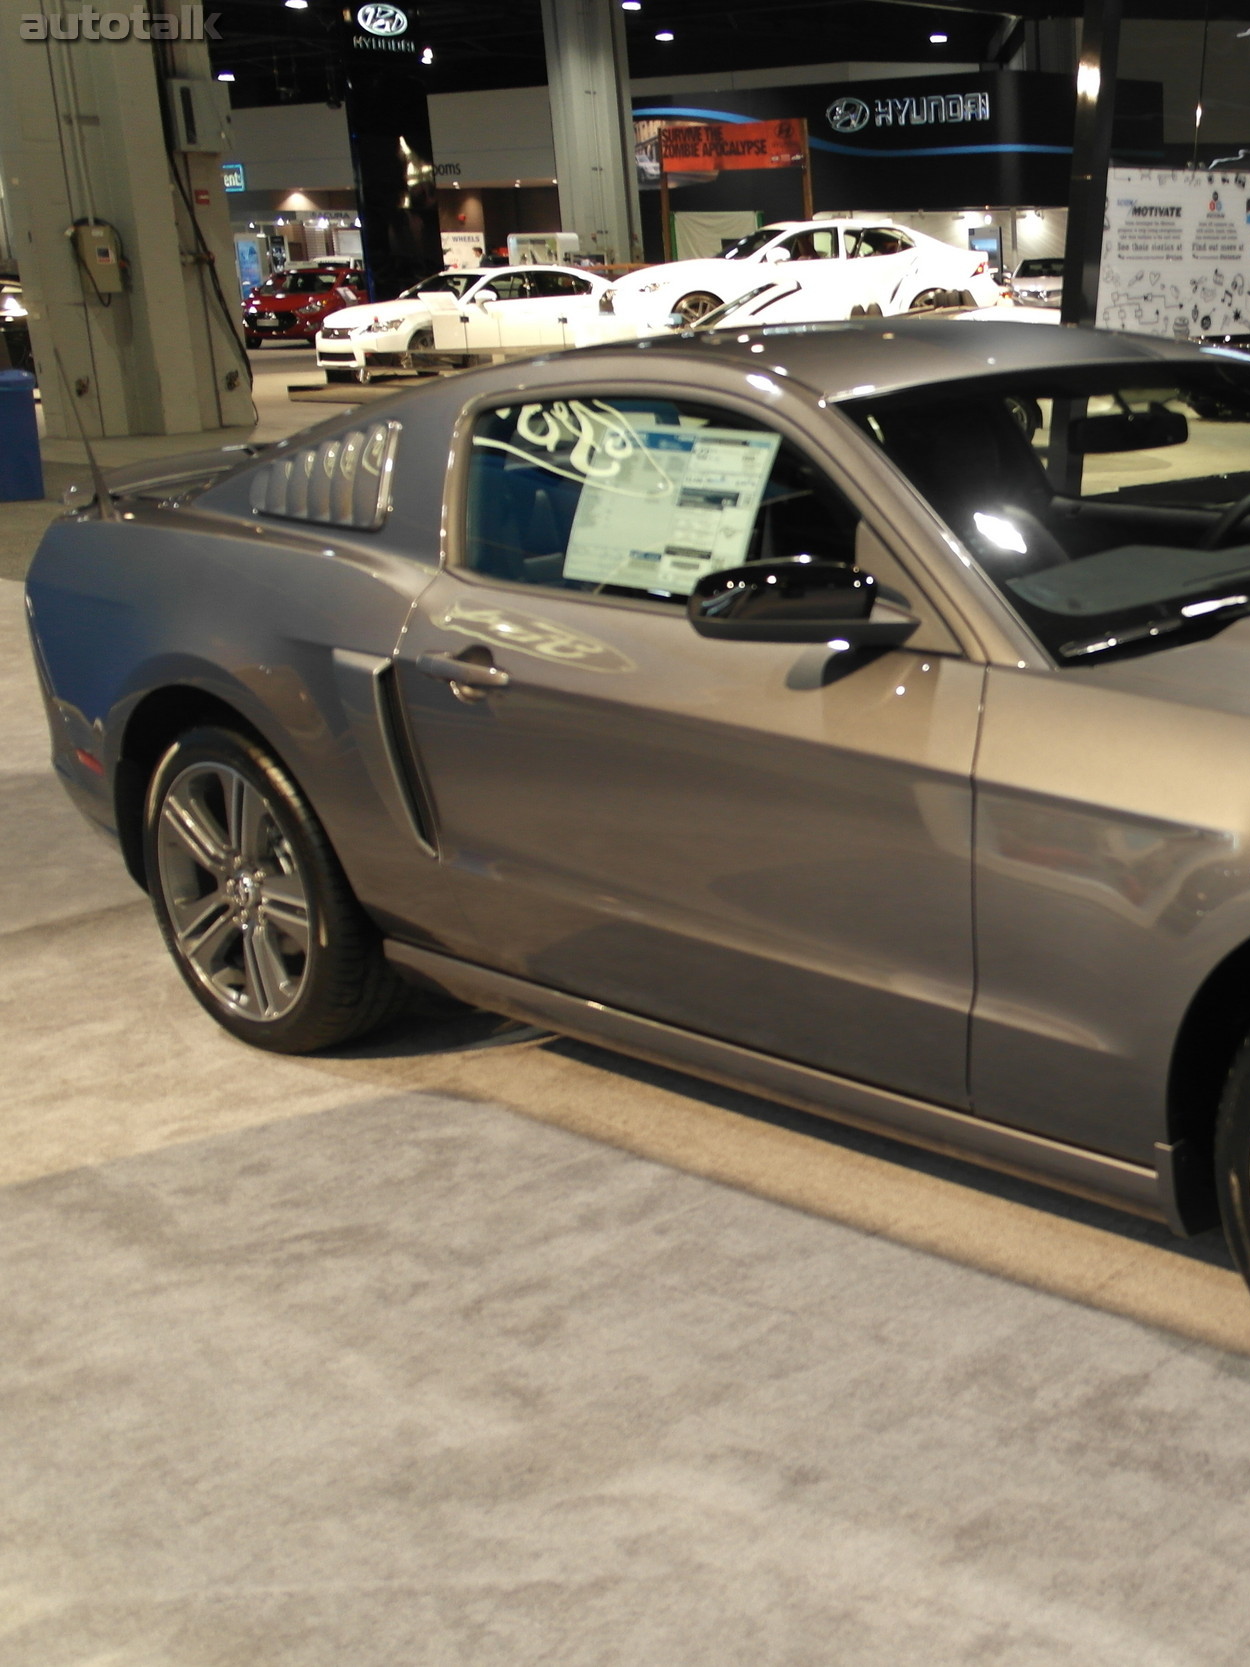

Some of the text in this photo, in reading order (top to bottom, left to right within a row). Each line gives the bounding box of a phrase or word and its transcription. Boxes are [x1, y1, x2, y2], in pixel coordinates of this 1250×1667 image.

[874, 92, 989, 127] HYUNDAI
[662, 126, 723, 143] SURVIVE THE
[663, 142, 700, 158] ZOMBIE
[702, 139, 767, 157] APOCALYPSE
[1132, 205, 1182, 217] MOTIVATE
